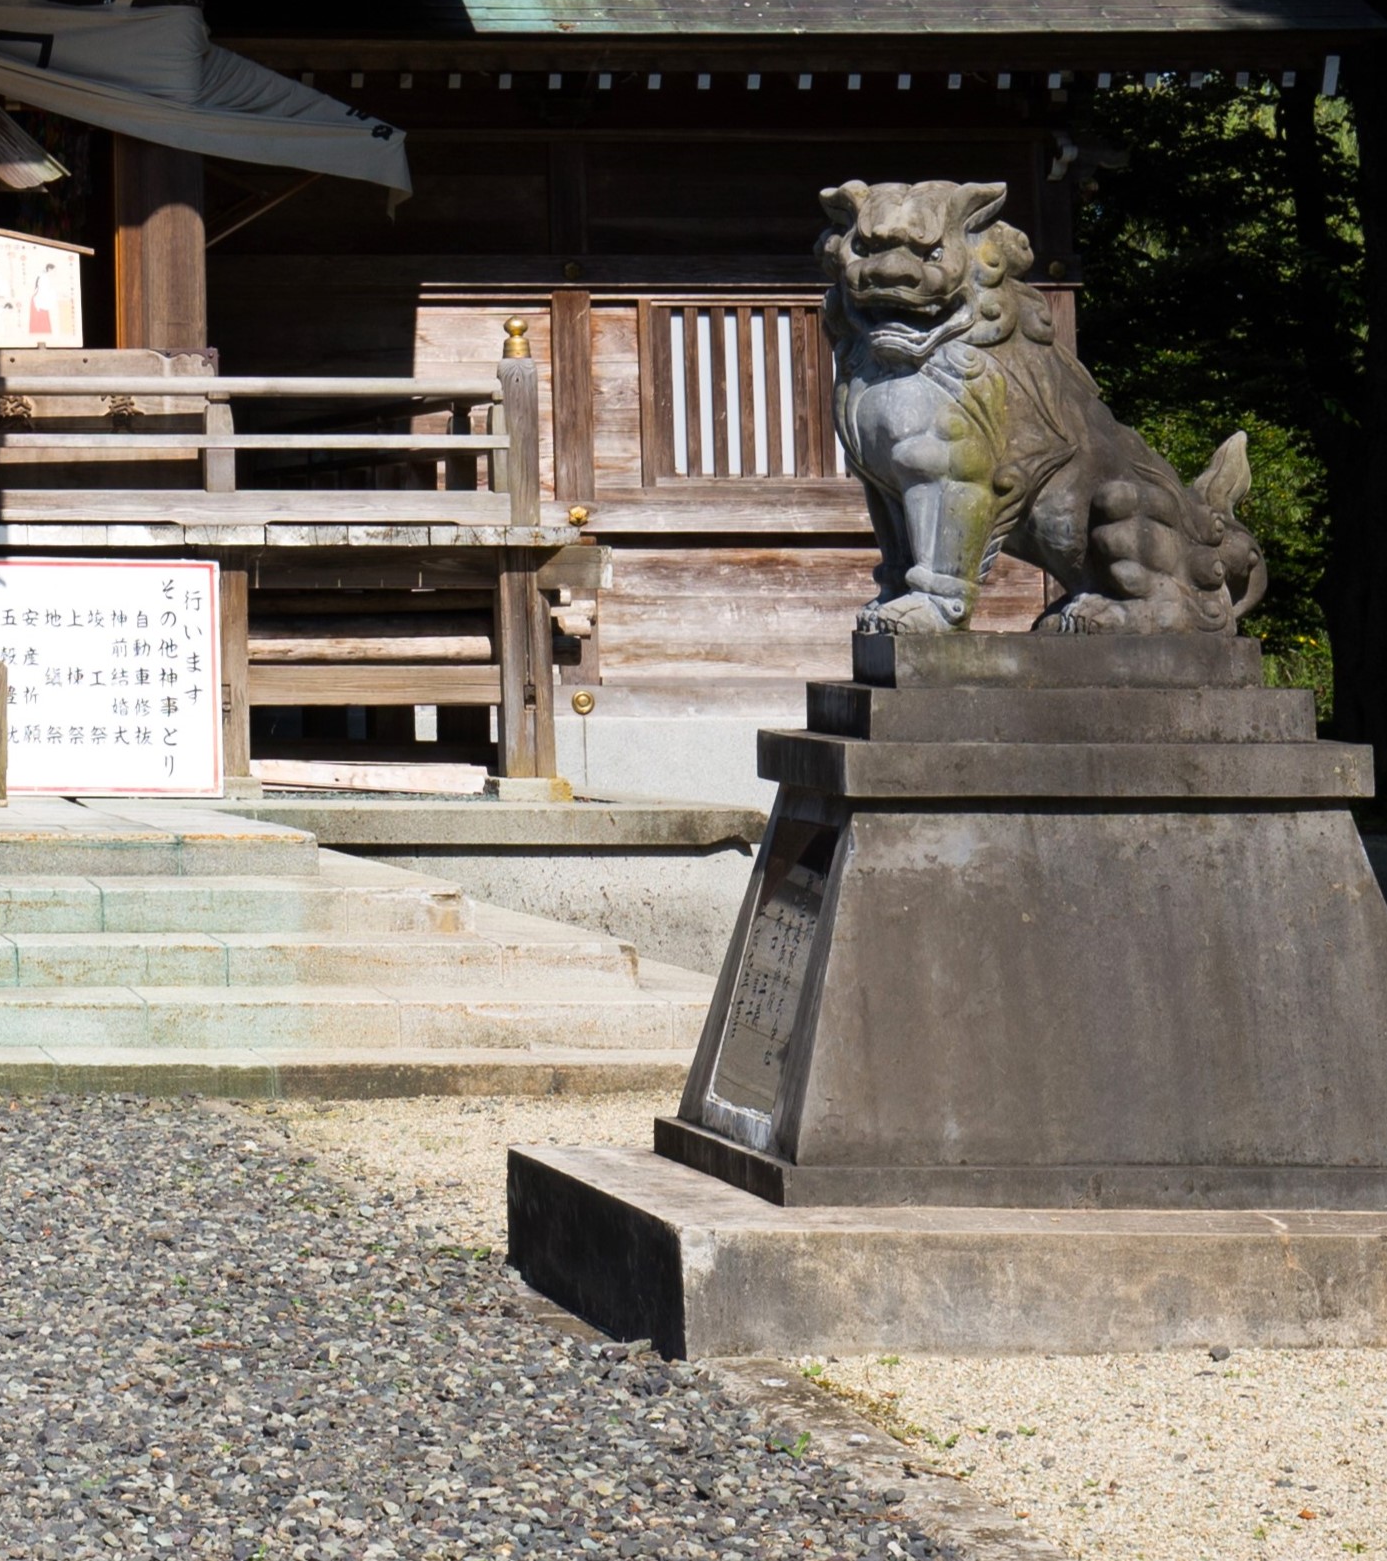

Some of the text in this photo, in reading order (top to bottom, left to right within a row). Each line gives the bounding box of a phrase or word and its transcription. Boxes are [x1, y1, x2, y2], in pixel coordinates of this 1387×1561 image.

[22, 608, 41, 744] 安産祈願
[67, 608, 85, 745] 上棟祭
[111, 609, 130, 746] 神前結婚式
[157, 578, 180, 778] その他神事とり
[184, 589, 203, 705] 行います
